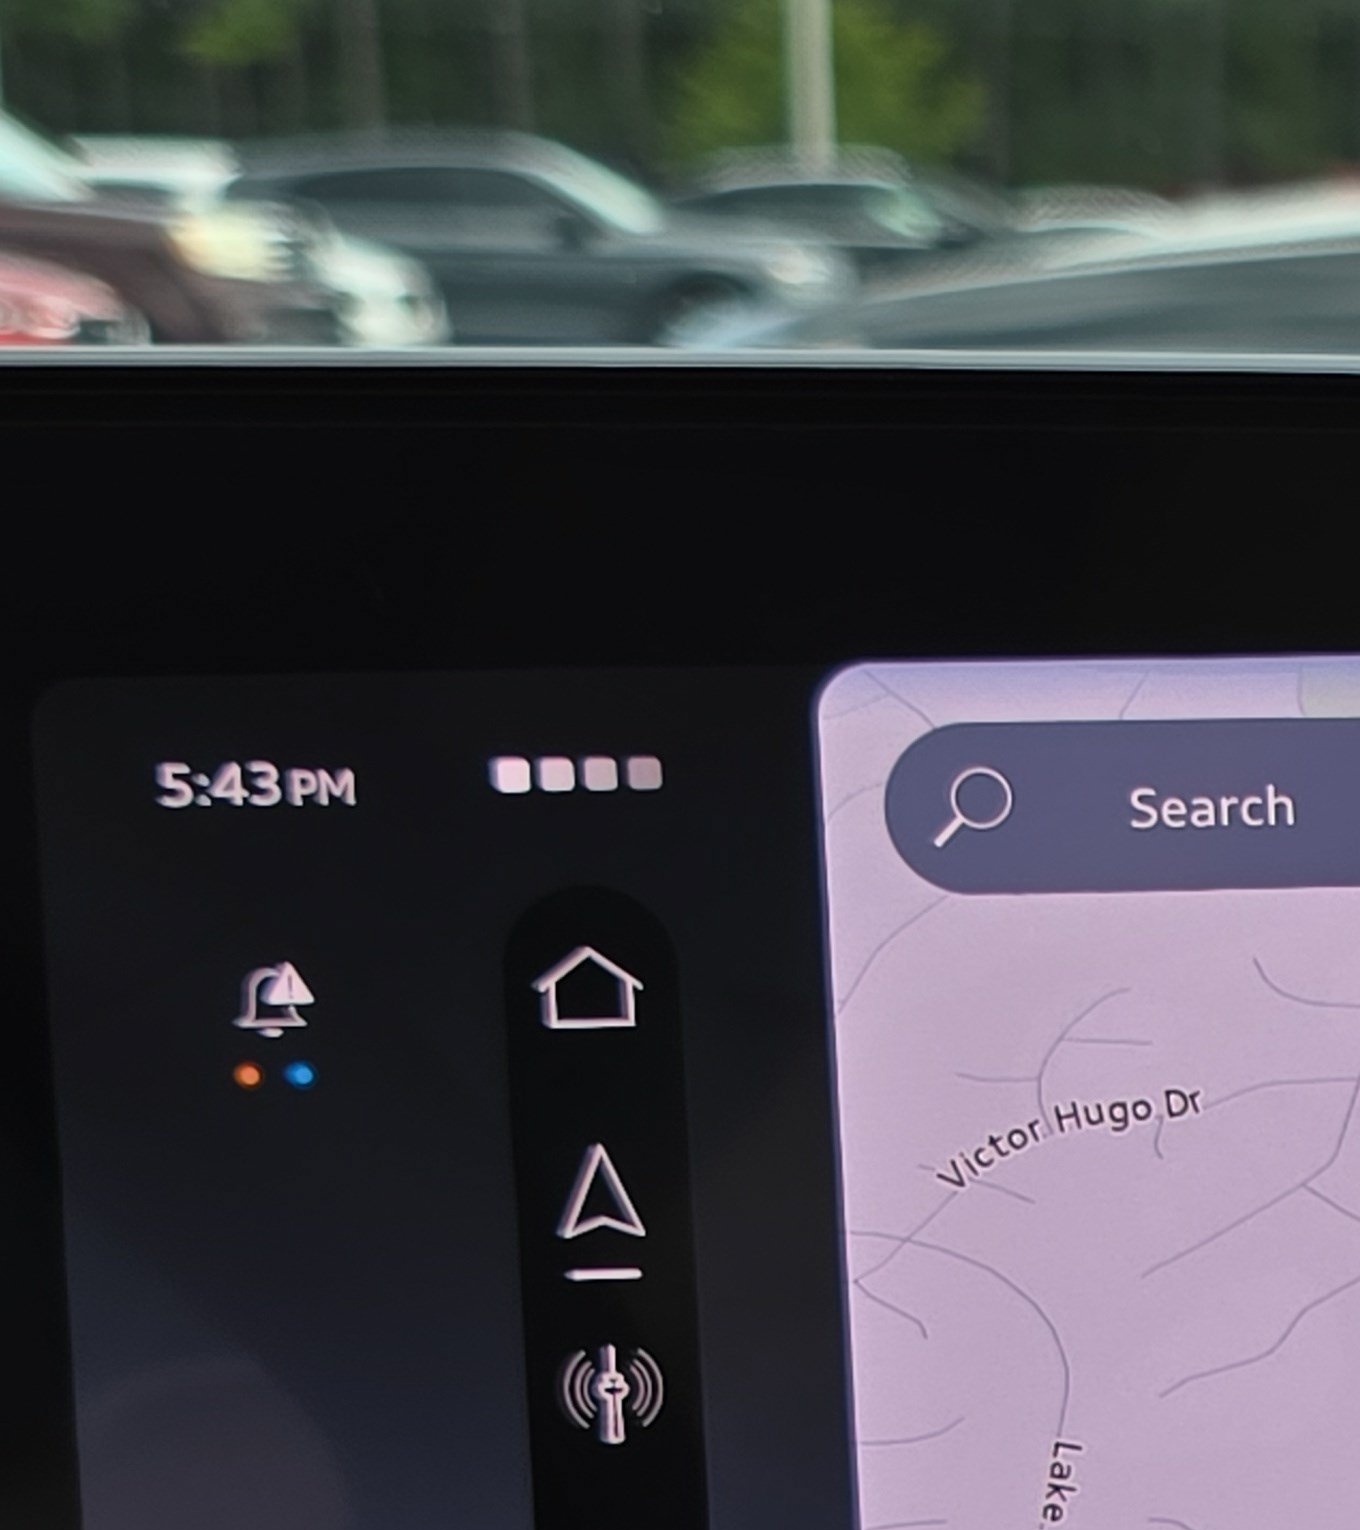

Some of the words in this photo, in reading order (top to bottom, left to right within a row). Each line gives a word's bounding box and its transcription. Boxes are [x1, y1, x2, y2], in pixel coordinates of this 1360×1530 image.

[1130, 784, 1296, 829] Search
[935, 1117, 1040, 1191] Victor
[1053, 1098, 1153, 1134] Hugo
[1163, 1088, 1201, 1119] Dr
[1041, 1440, 1084, 1523] Lake
